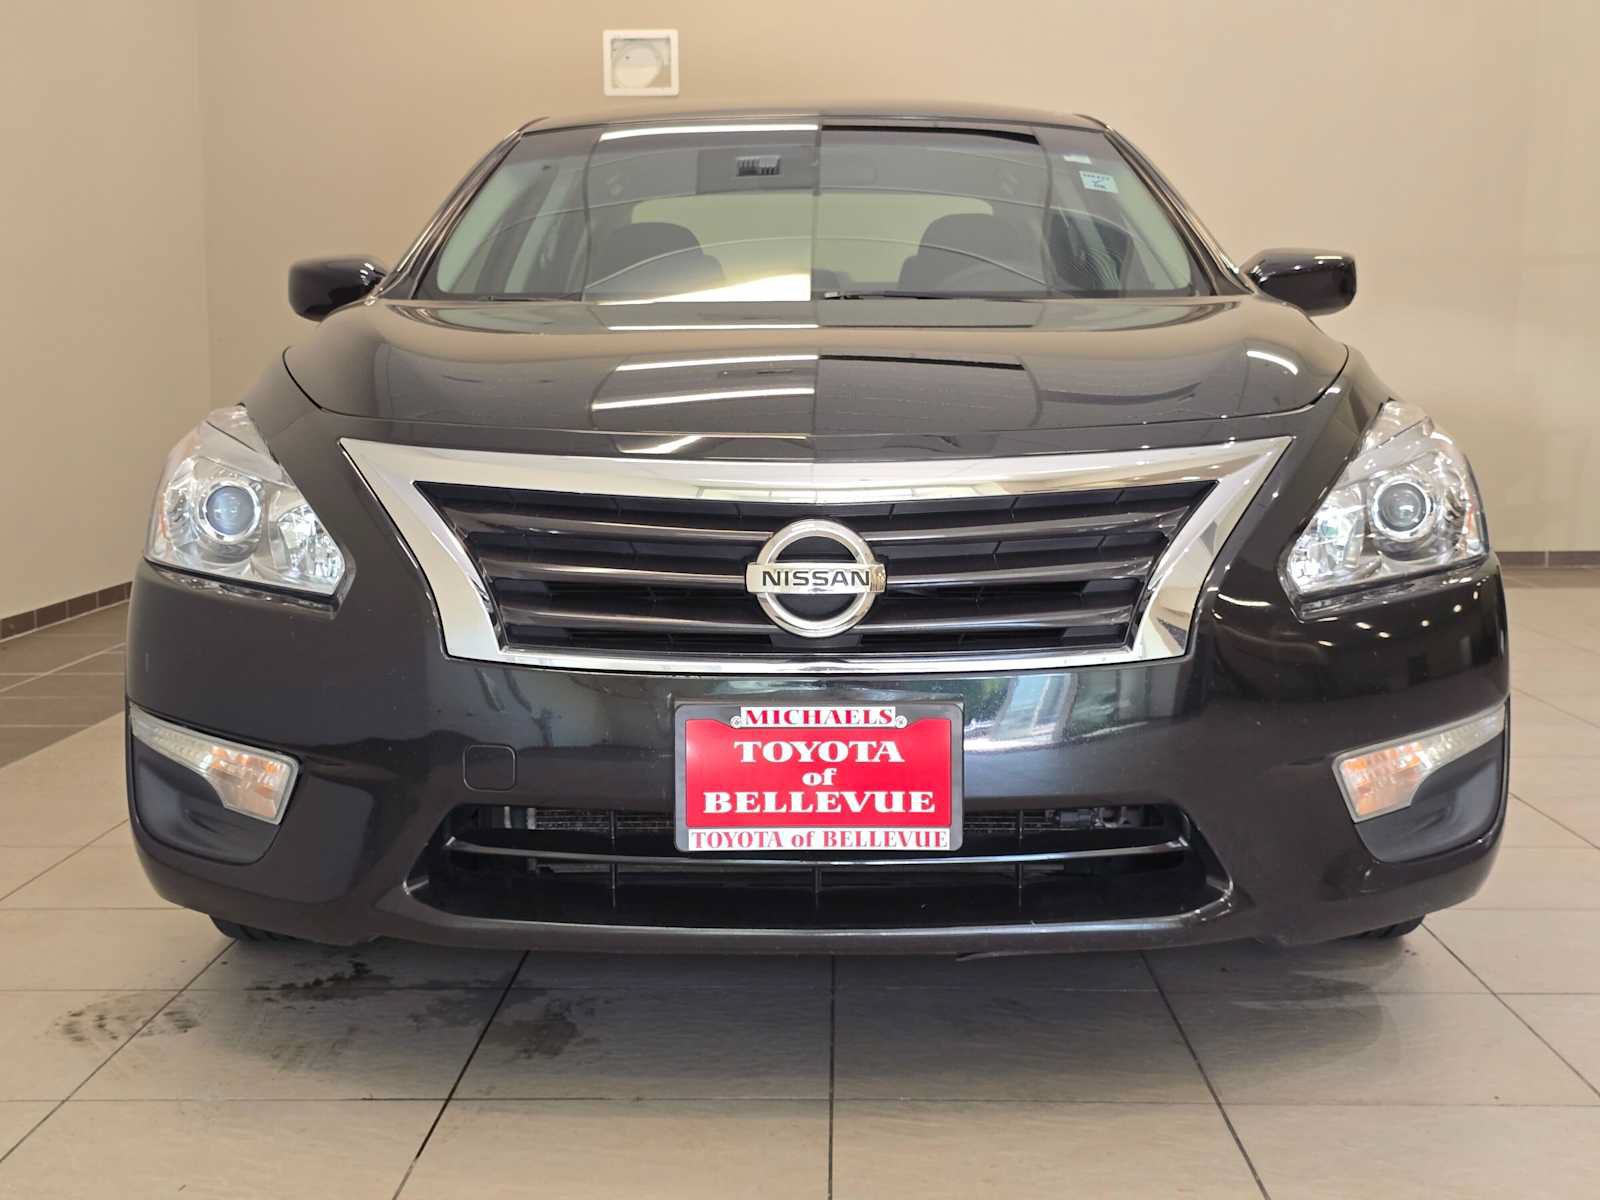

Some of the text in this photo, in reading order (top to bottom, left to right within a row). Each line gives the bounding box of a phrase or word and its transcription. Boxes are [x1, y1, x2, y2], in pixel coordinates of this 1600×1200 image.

[762, 570, 870, 587] NISSAN
[745, 709, 893, 725] MICHAELS
[733, 740, 905, 763] TOYOTA
[801, 767, 838, 787] of
[703, 790, 936, 814] BELLEVUE
[690, 830, 948, 849] TOYOTA of BELLEVUE
